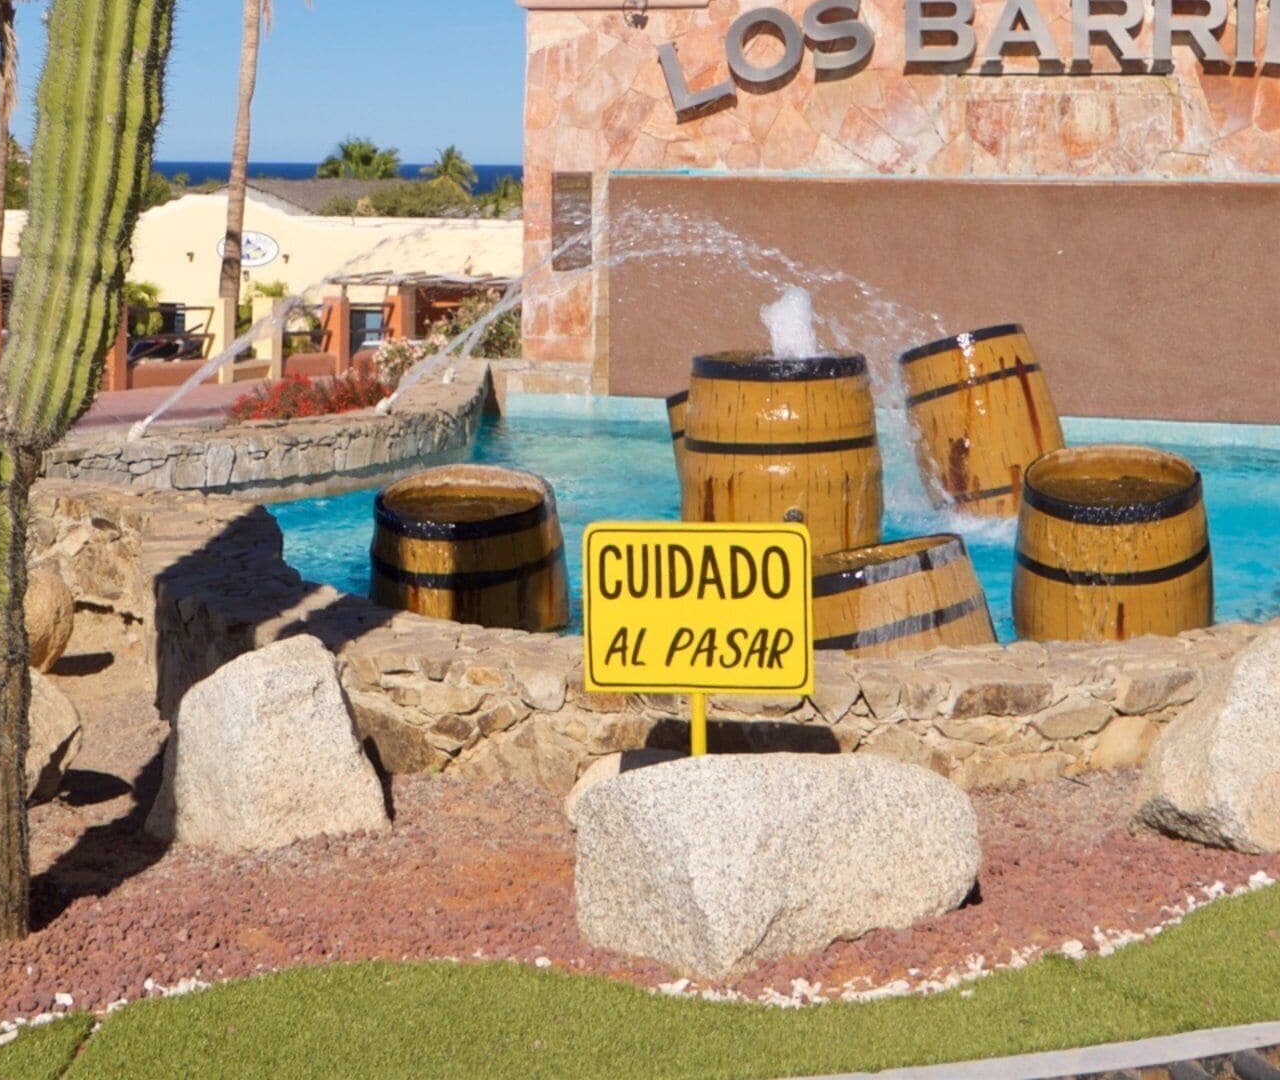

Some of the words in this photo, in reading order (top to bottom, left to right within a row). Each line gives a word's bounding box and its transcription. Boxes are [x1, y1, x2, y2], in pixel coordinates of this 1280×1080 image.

[598, 543, 791, 601] CUIDADO
[604, 626, 648, 667] AL
[664, 626, 795, 670] PASAR
